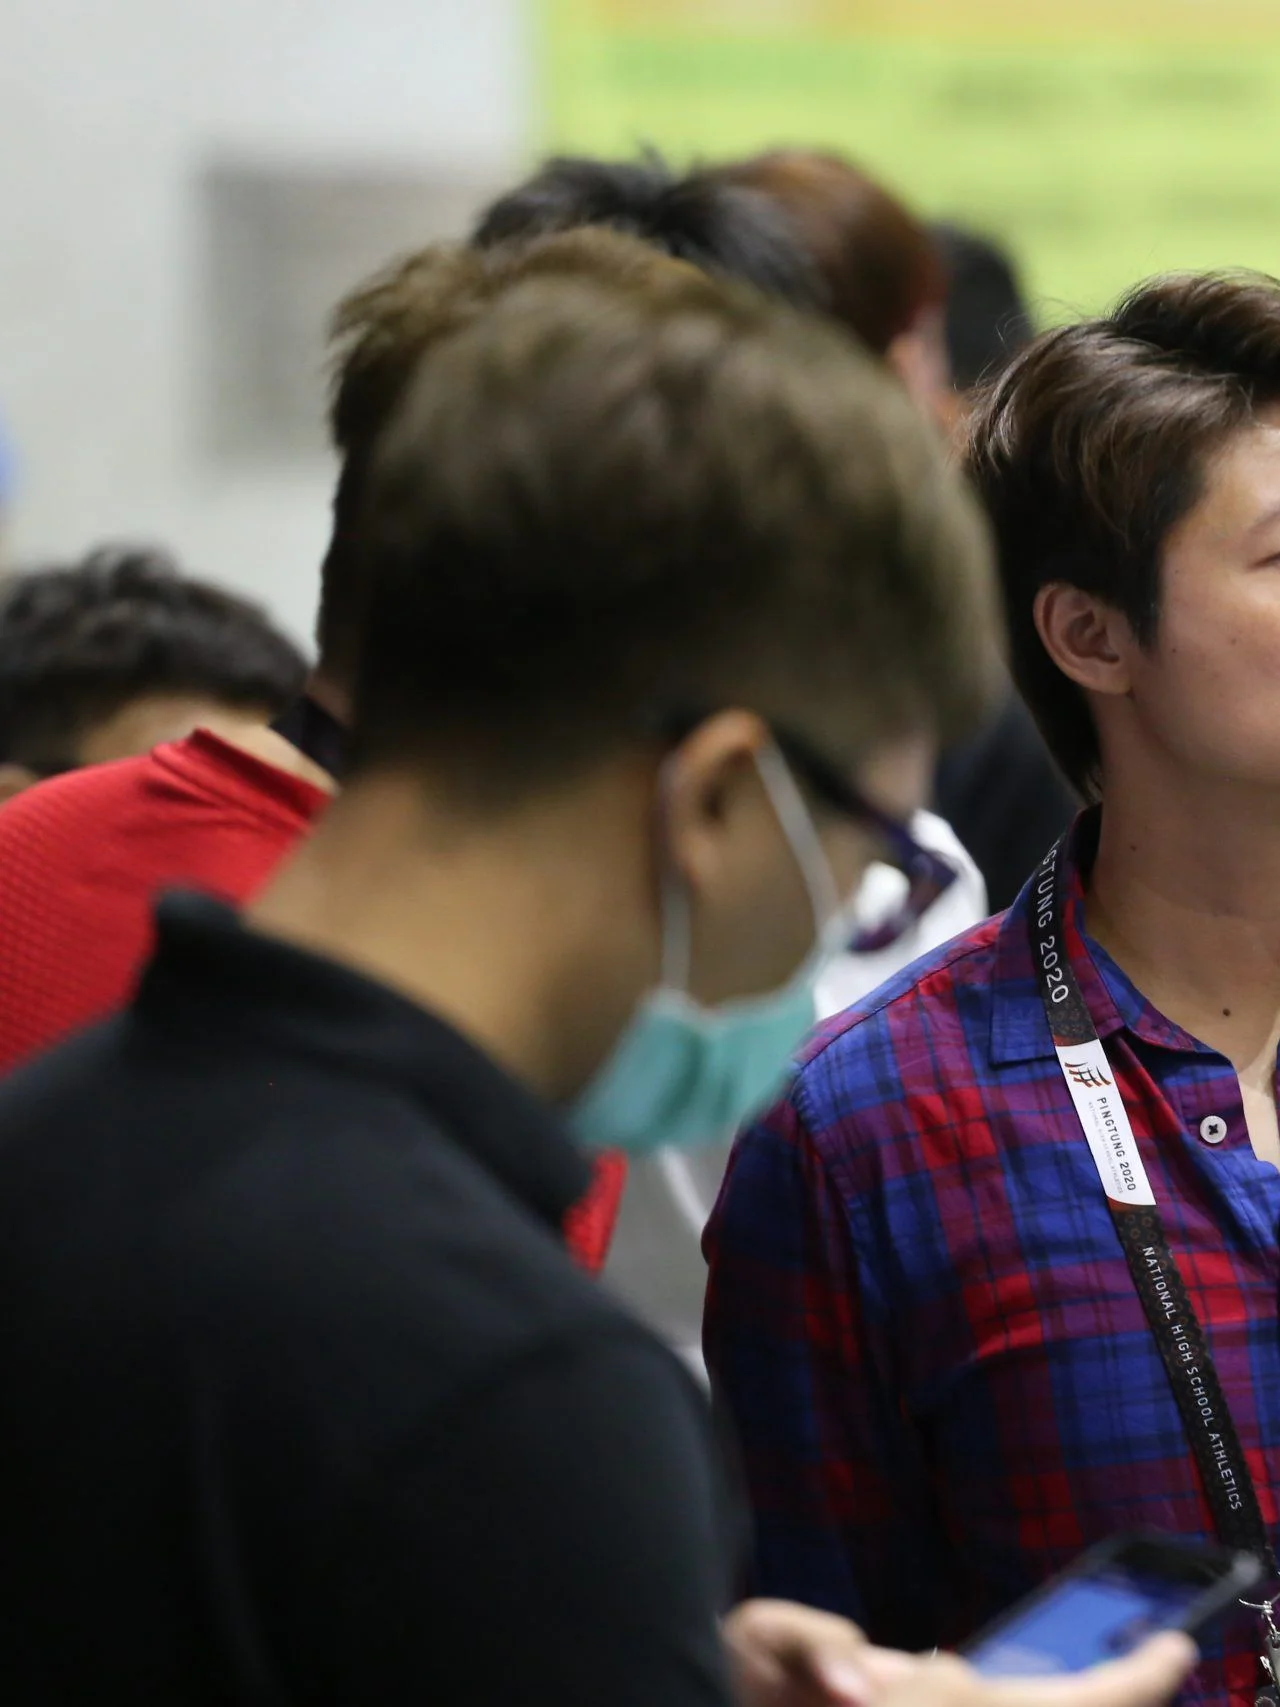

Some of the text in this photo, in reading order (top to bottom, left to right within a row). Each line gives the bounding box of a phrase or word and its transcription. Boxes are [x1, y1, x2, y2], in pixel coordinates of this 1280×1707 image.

[1040, 936, 1069, 1003] 2020
[1096, 1096, 1125, 1158] PINGTUNG
[1119, 1161, 1136, 1191] 2020
[1142, 1246, 1242, 1510] NATIONAL HIGH SCHOOL ATHLETICS
